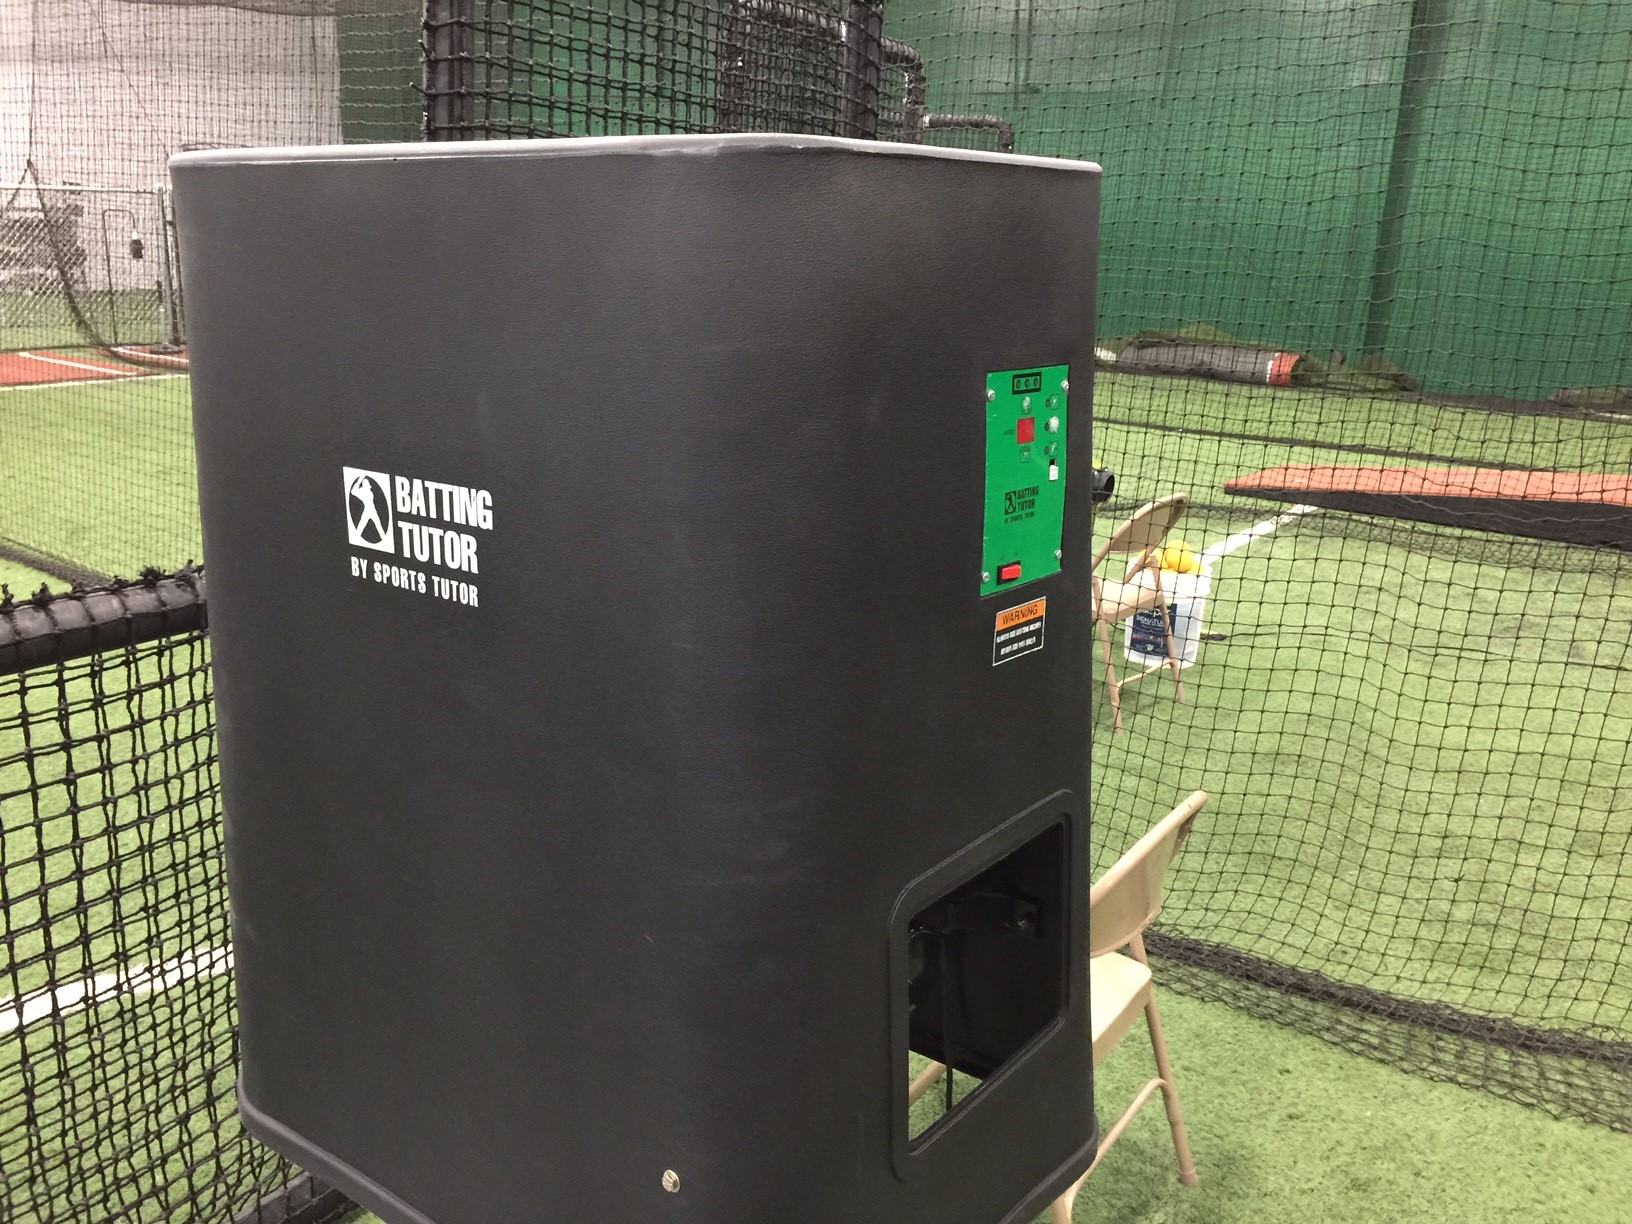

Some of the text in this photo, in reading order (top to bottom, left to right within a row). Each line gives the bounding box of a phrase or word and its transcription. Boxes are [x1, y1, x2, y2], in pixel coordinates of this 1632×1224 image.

[395, 475, 493, 530] BATTING
[1017, 499, 1035, 512] TUTOR
[397, 520, 479, 574] TUTOR
[351, 556, 479, 608] BY SPORTS TUTOR
[1002, 604, 1038, 625] WARNING
